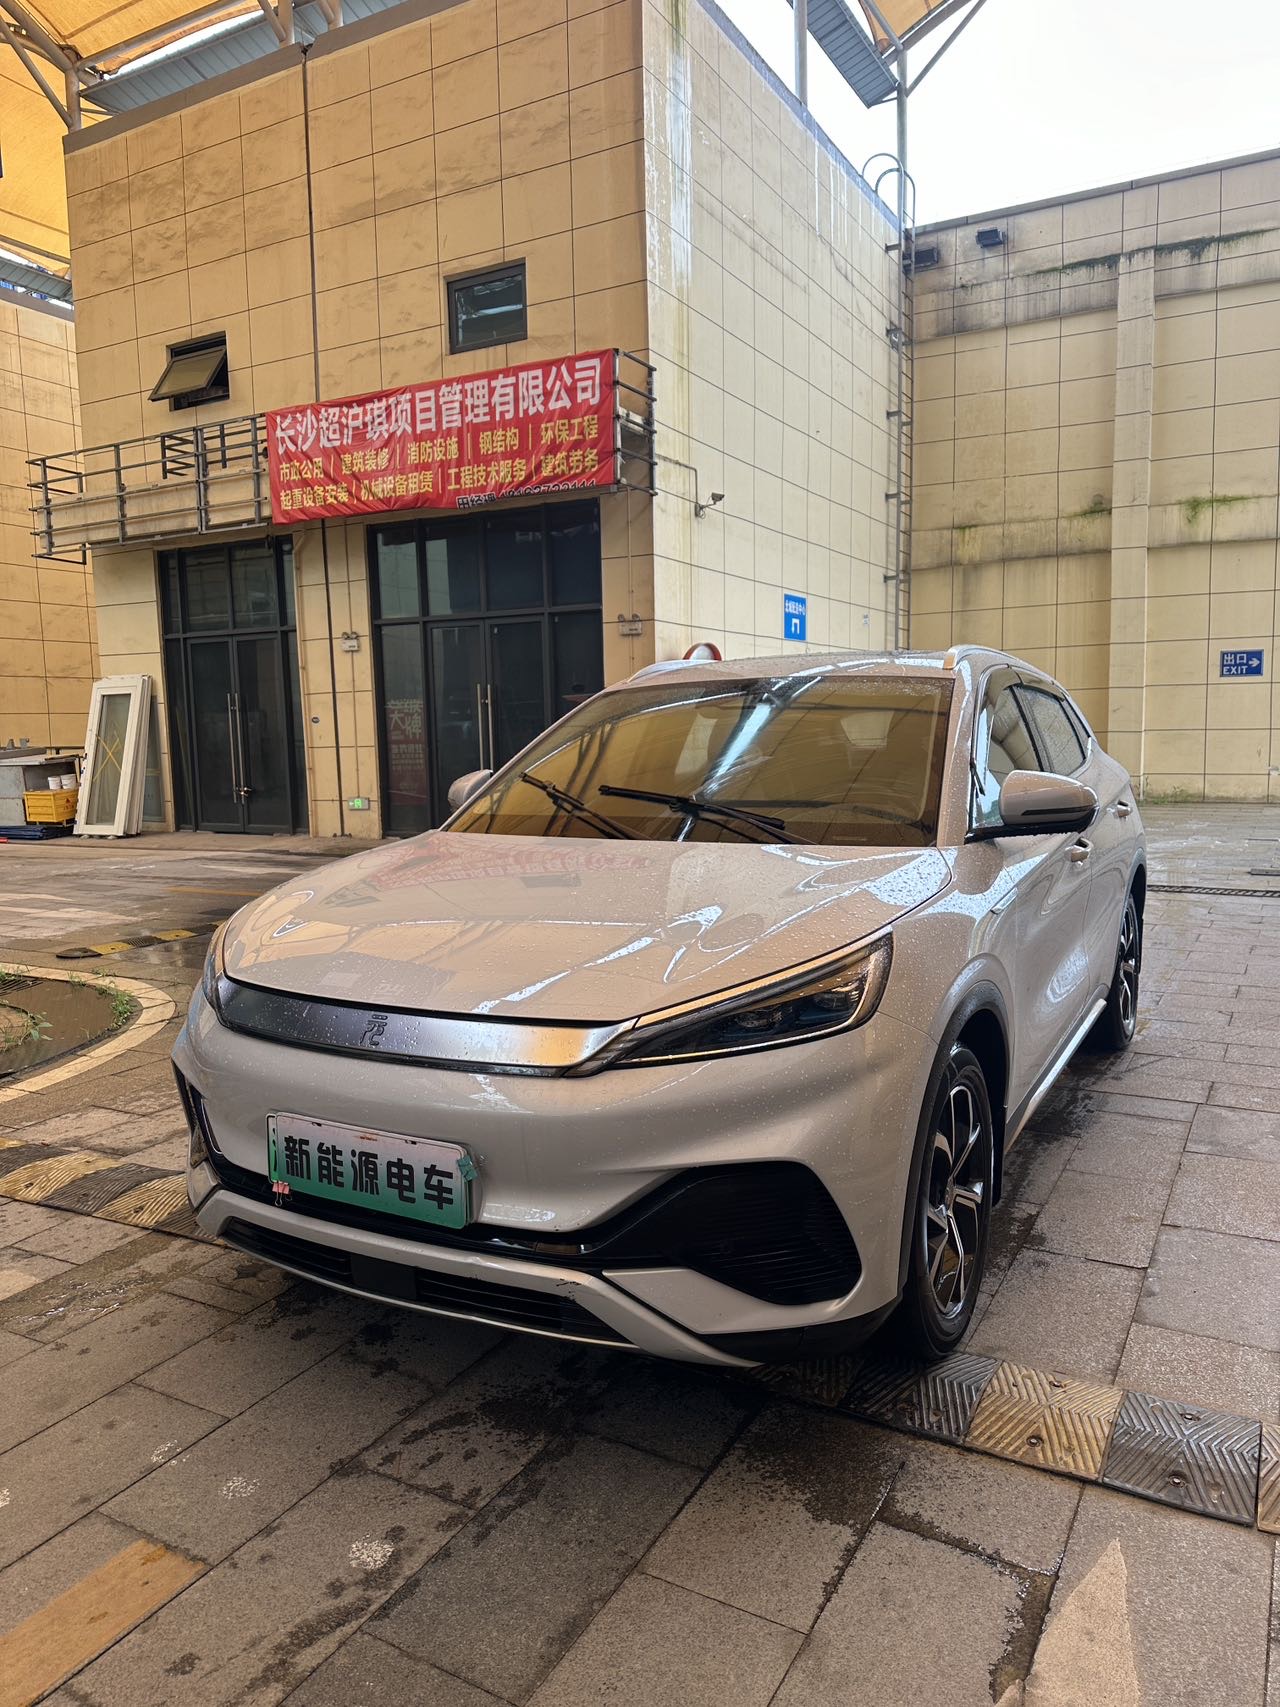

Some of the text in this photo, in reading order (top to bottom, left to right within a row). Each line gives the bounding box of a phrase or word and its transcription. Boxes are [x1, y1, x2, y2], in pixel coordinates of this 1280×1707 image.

[276, 358, 600, 455] 长沙超沪琪项目管理有限公司
[280, 414, 598, 483] 市政公用 建筑装修 消防设施 钢结构 环保工程
[280, 447, 599, 511] 起重设备安装 机械设备租赁 工程技术服务 建筑劳务
[1223, 653, 1247, 665] 出口
[1223, 666, 1248, 675] EXIT
[284, 1135, 454, 1210] 新能源电车
